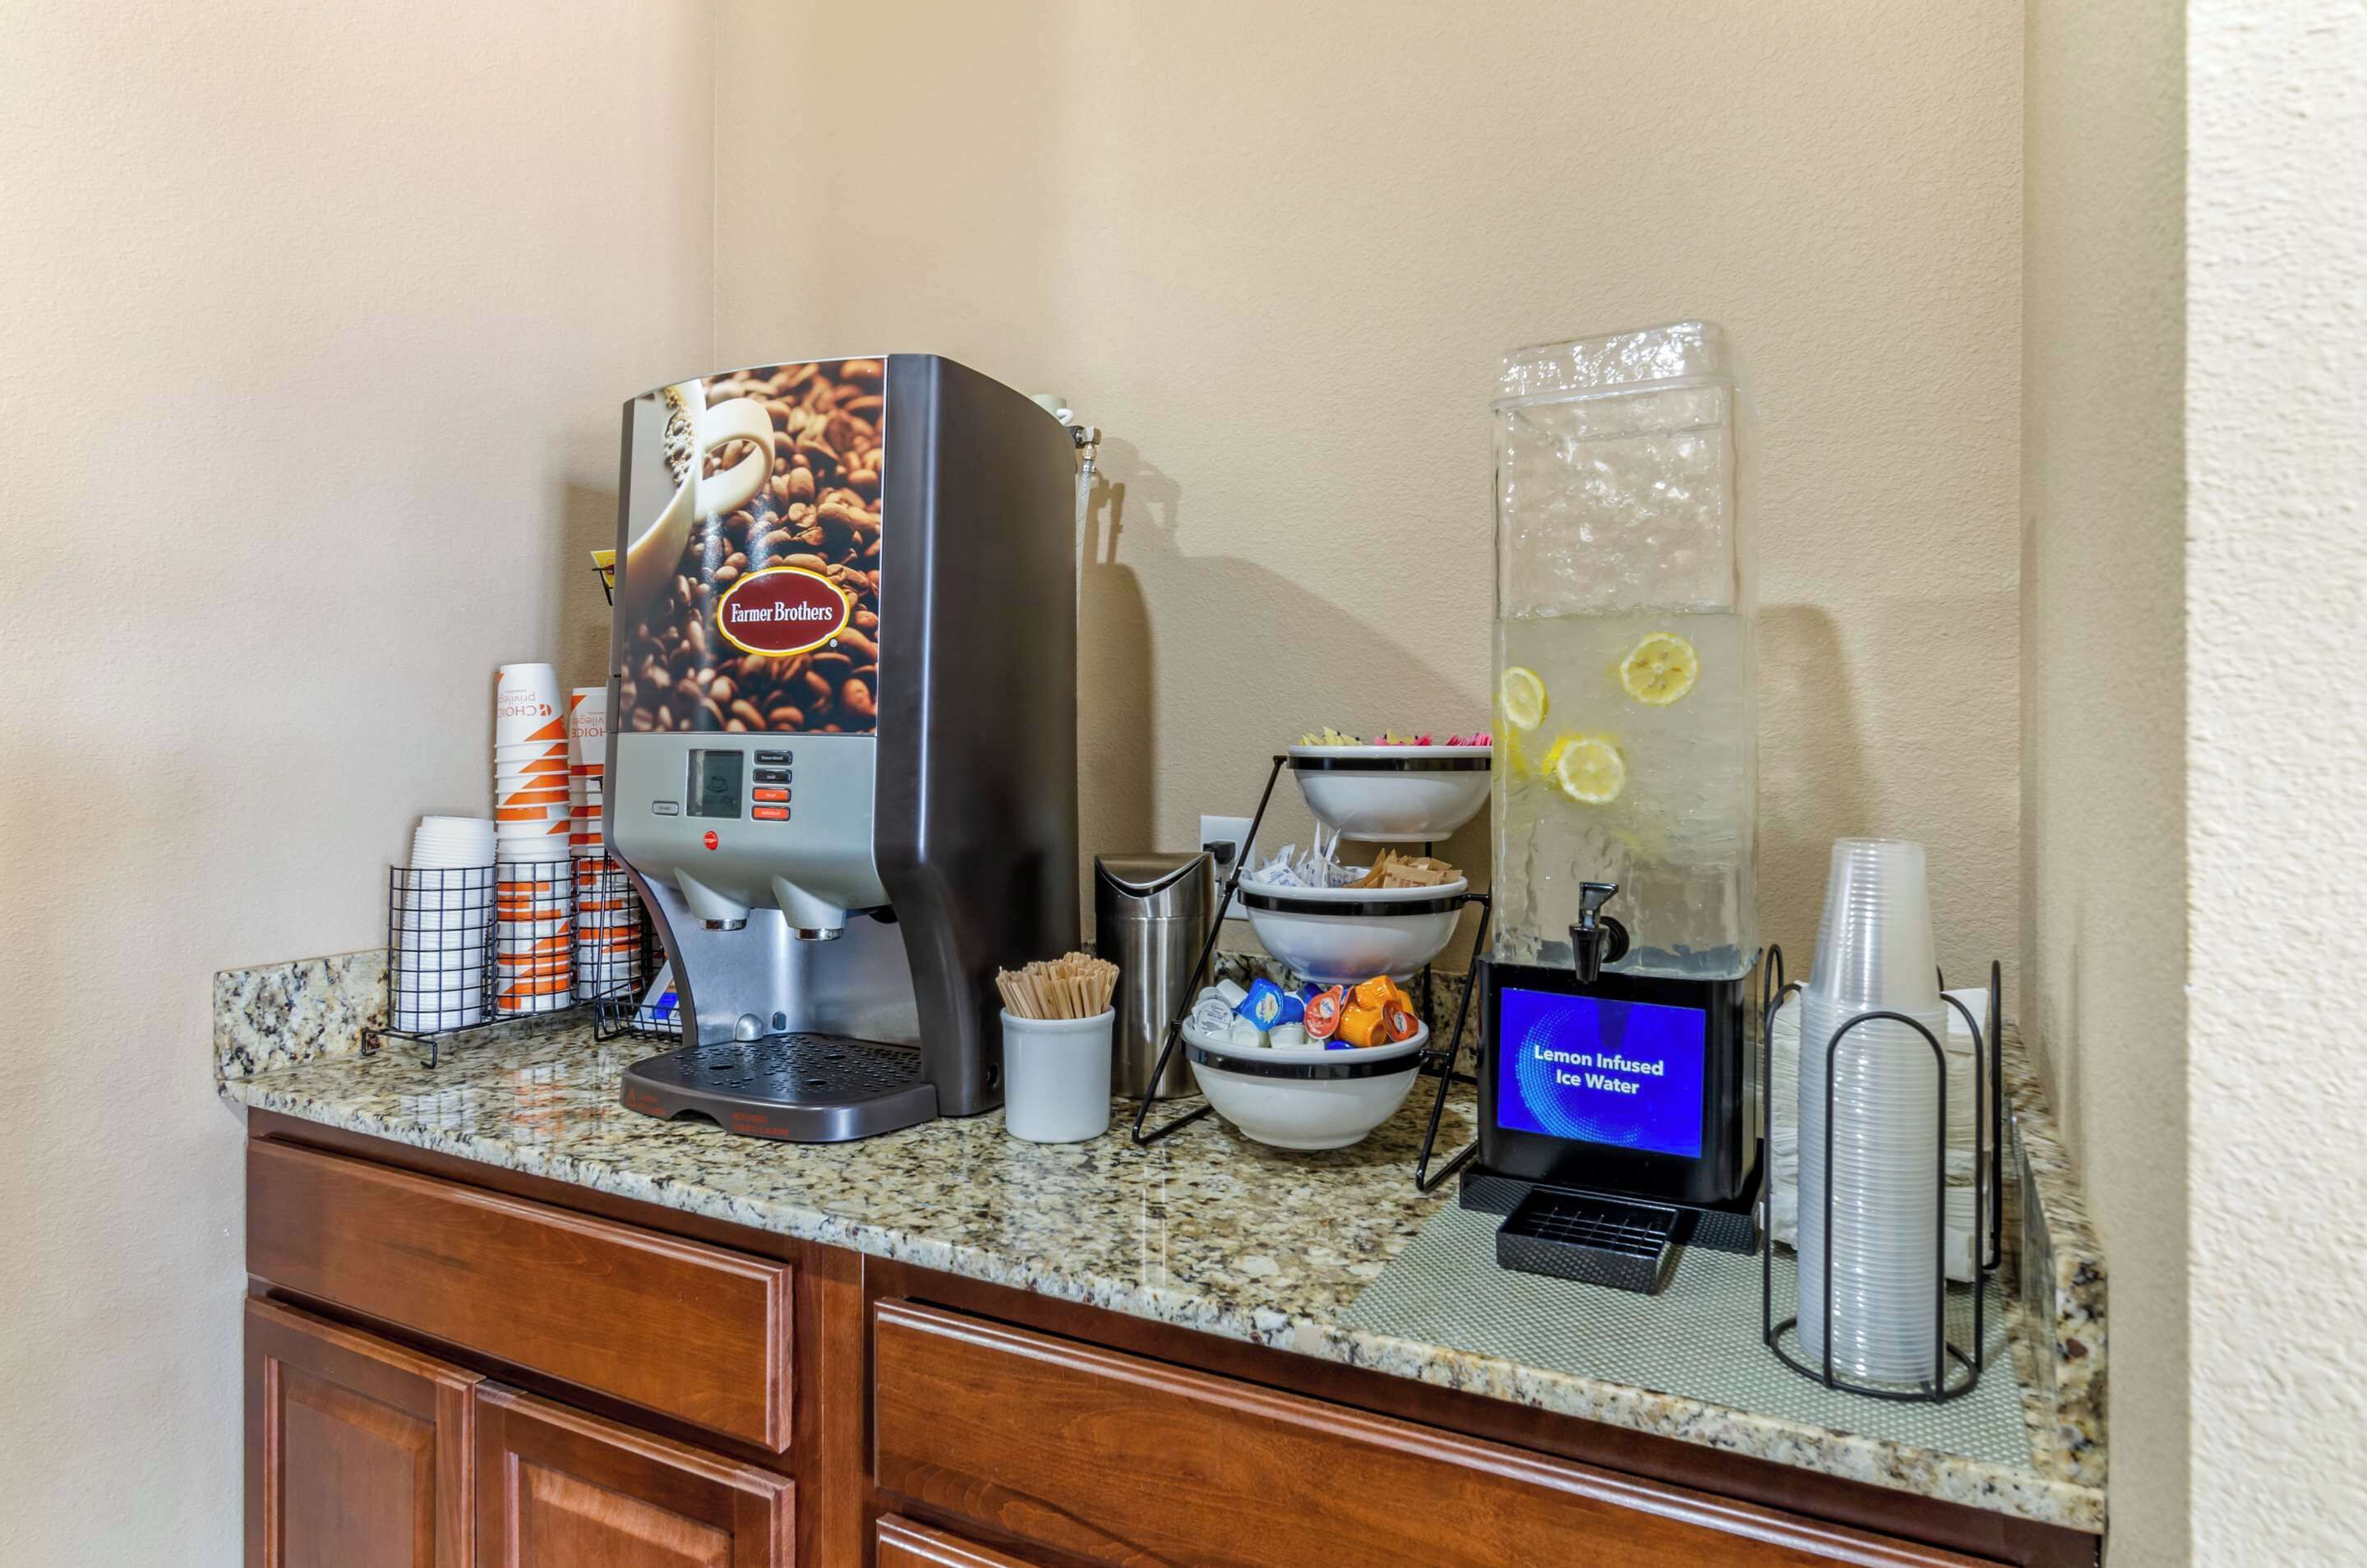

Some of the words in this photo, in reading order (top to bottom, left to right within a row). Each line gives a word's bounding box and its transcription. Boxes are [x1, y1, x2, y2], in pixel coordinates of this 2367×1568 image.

[731, 603, 773, 623] Farmer
[774, 601, 833, 621] Brothers
[498, 705, 537, 718] CHOIC
[571, 727, 607, 738] HOICE
[1534, 1045, 1592, 1067] Lemon
[1597, 1053, 1664, 1077] Infused
[1556, 1069, 1581, 1086] Ice
[1585, 1073, 1640, 1095] Water
